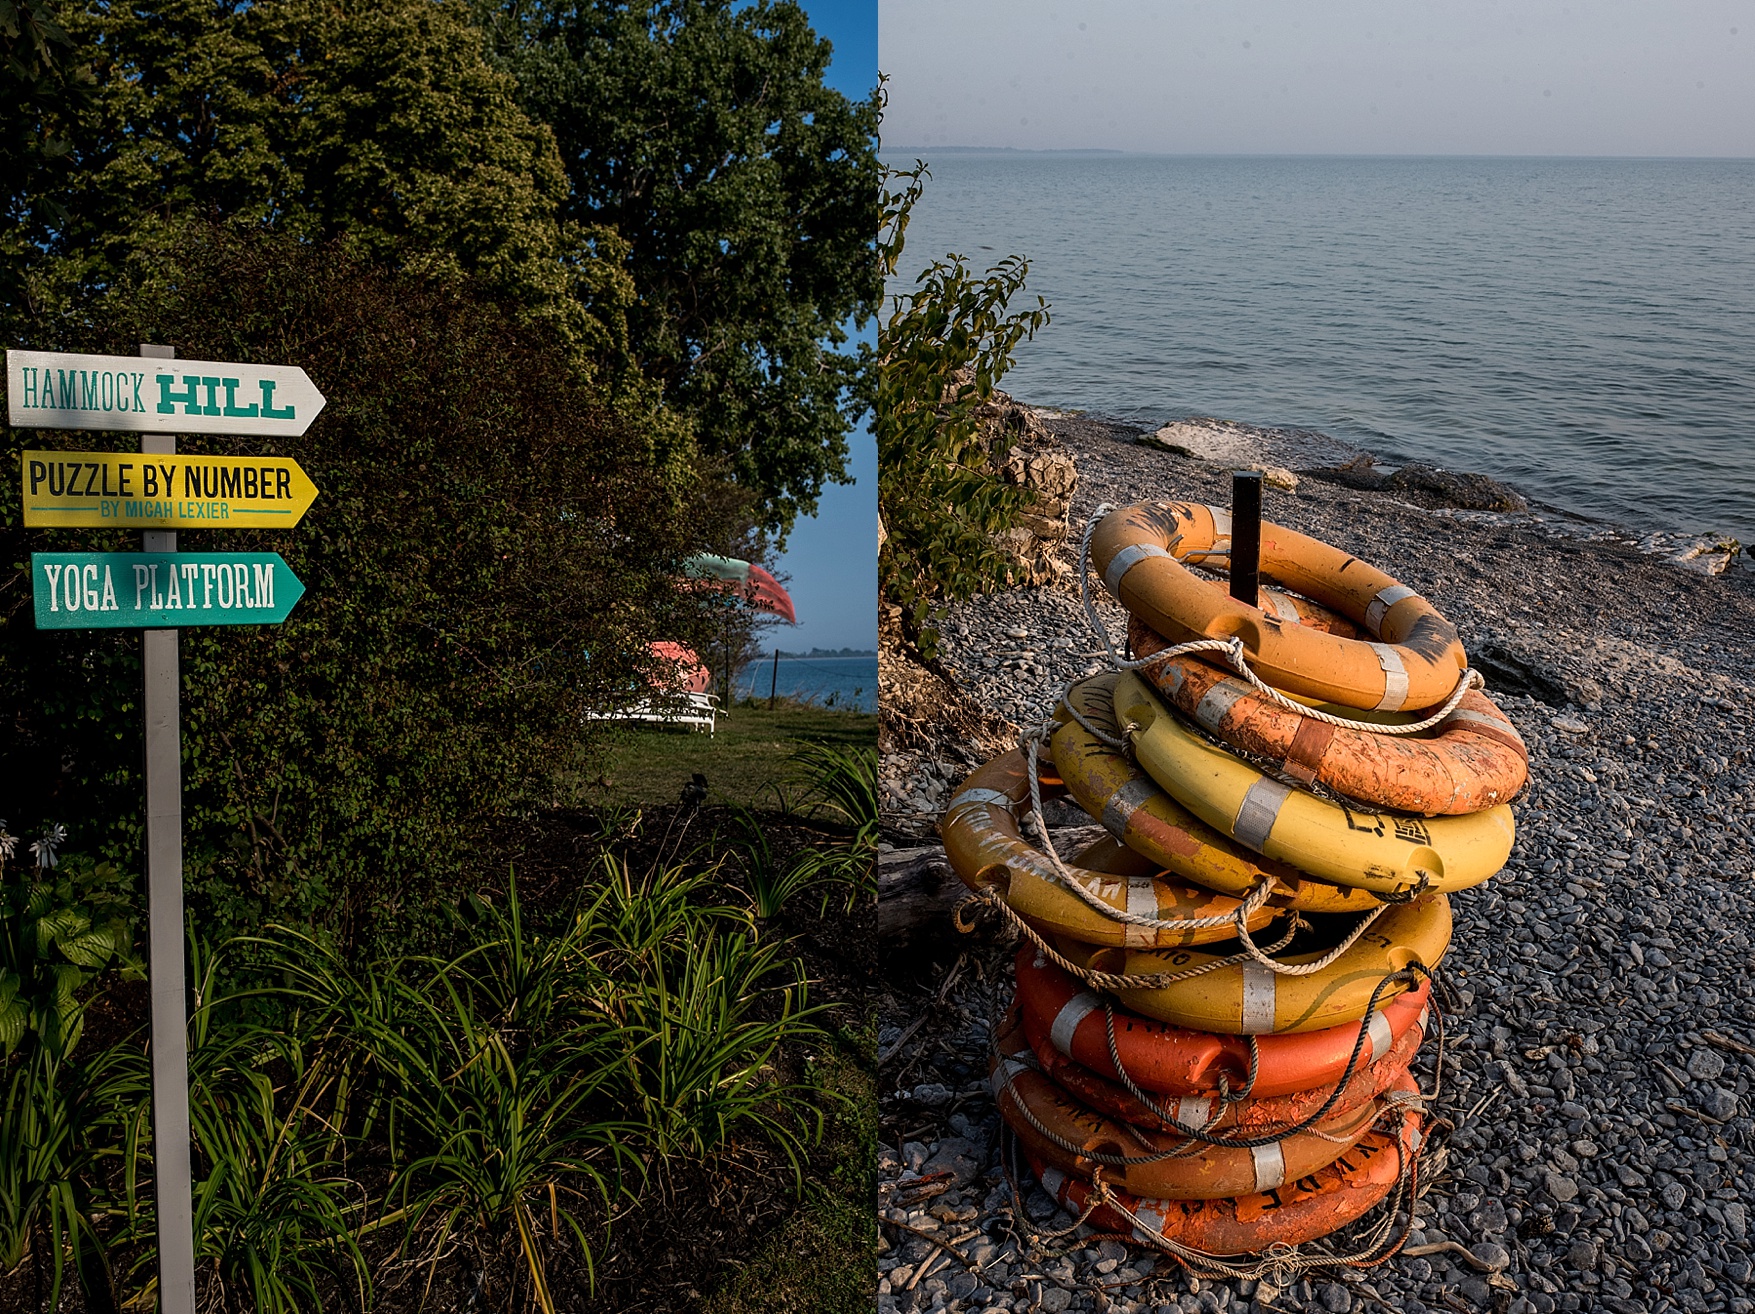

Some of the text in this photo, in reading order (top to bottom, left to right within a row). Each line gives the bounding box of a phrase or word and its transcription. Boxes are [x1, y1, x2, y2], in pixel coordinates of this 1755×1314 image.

[22, 367, 296, 420] HAMMOCK HILL
[29, 460, 293, 499] PUZZLE BY NUMBER
[101, 501, 230, 519] BY MICAH LEXIER
[44, 563, 275, 612] YOGA PLATFORM
